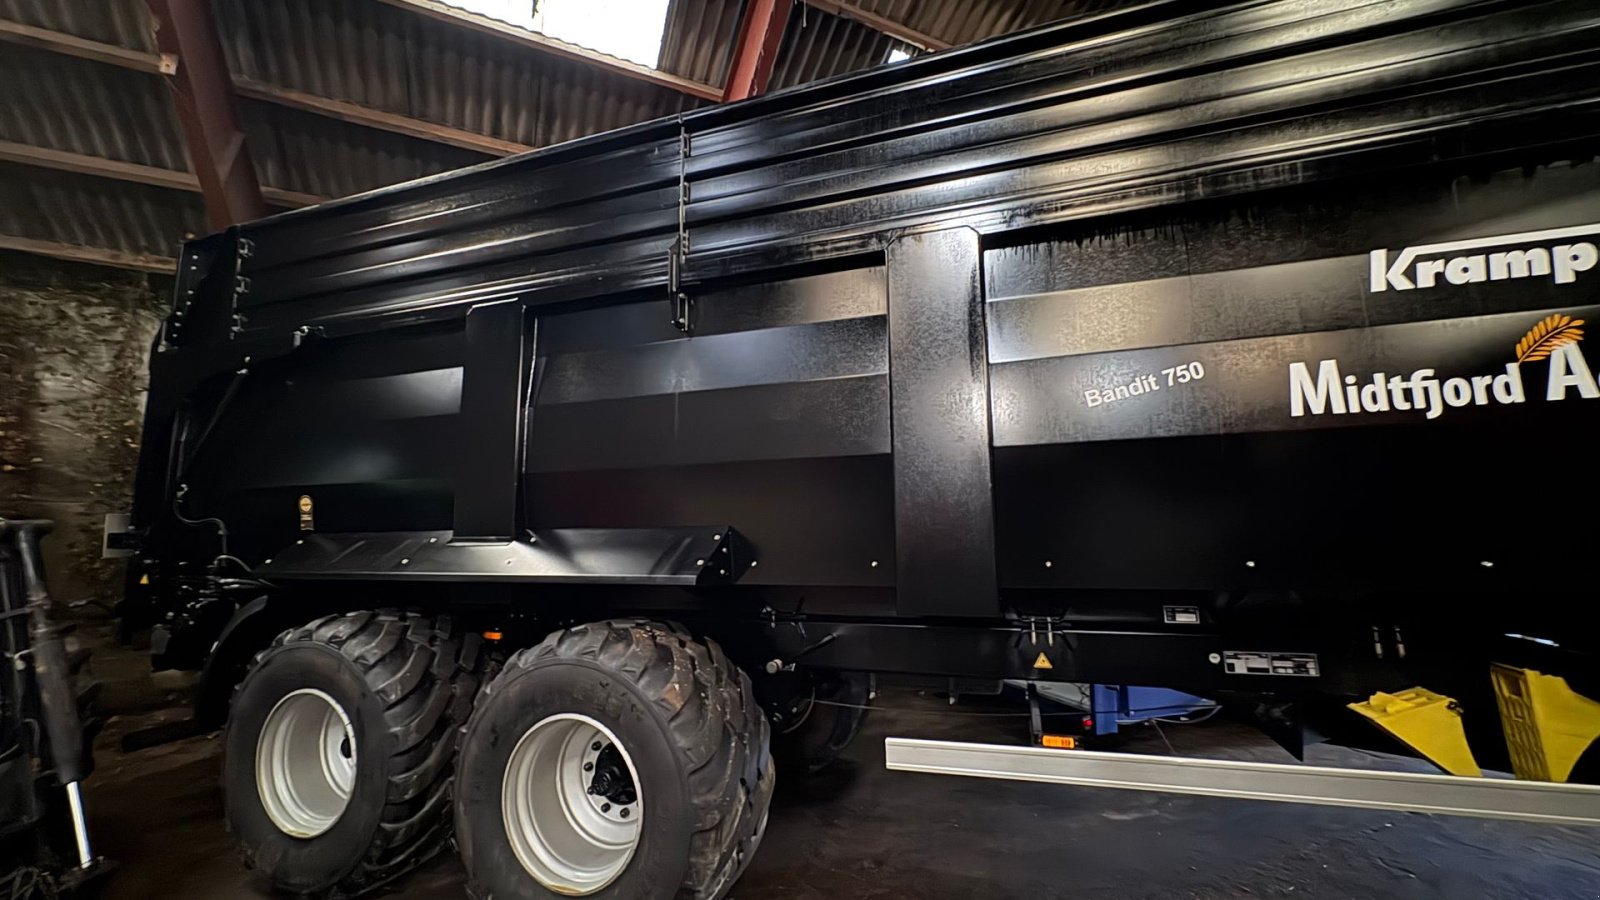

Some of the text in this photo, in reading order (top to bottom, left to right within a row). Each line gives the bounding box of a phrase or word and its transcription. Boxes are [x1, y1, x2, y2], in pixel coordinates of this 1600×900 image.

[1084, 361, 1205, 408] Bandit 750
[1289, 342, 1600, 419] Midtfjord A
